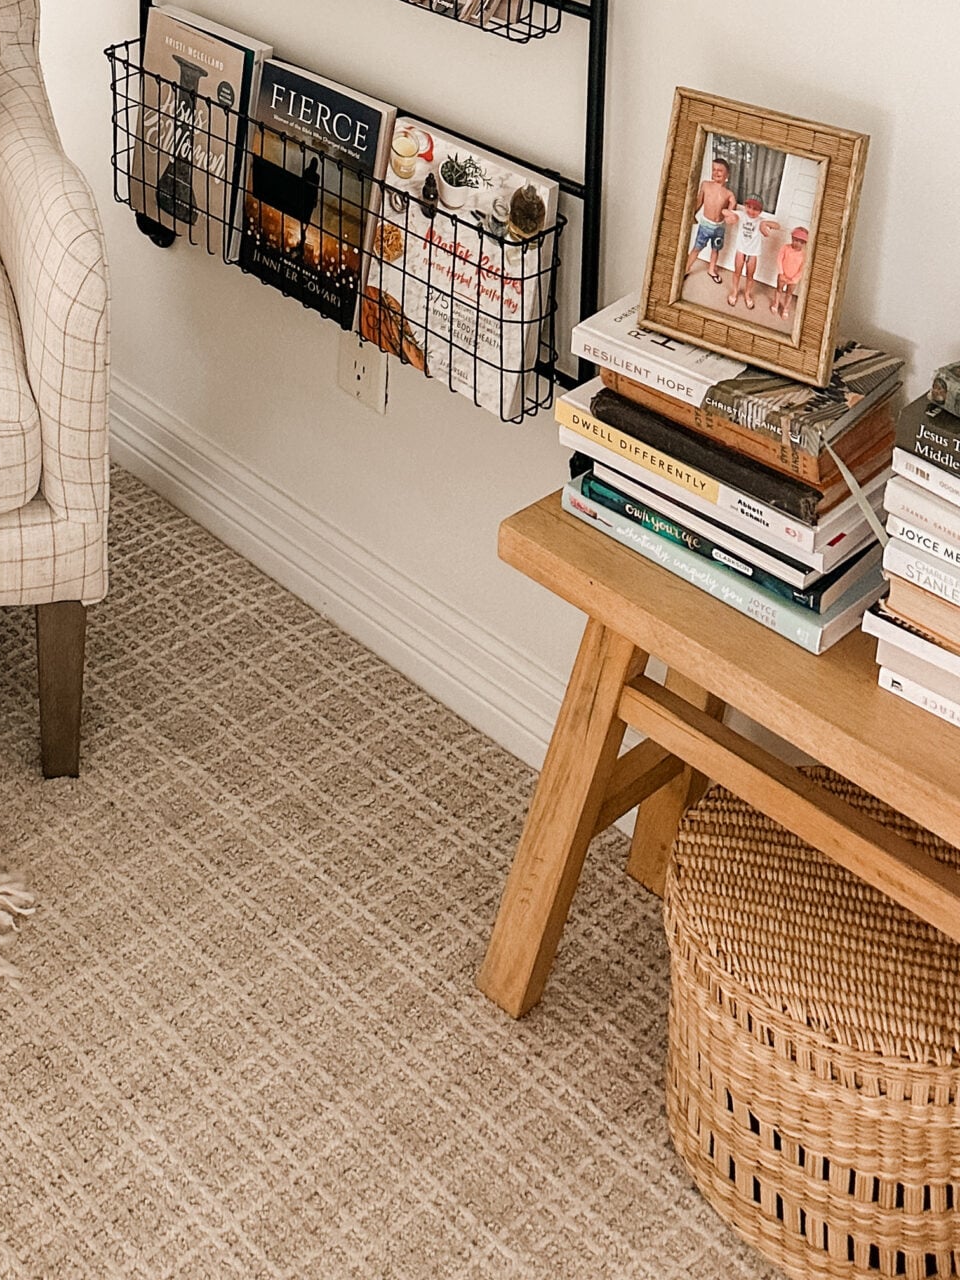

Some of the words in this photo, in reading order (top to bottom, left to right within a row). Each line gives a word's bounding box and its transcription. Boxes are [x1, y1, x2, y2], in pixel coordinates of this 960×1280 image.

[164, 36, 186, 53] KRISTI
[270, 83, 370, 152] FIERCE
[583, 343, 652, 379] RESILIENT
[656, 375, 694, 398] HOPE
[705, 397, 753, 422] CHRISTINE
[916, 424, 949, 448] Jesus
[572, 414, 614, 443] DWELL
[619, 439, 707, 491] DIFFERENTLY
[914, 441, 960, 470] Middle
[899, 527, 940, 553] JOYCE
[713, 551, 751, 573] CLARKSON
[746, 607, 777, 628] MEYER
[748, 597, 777, 618] JOYCE
